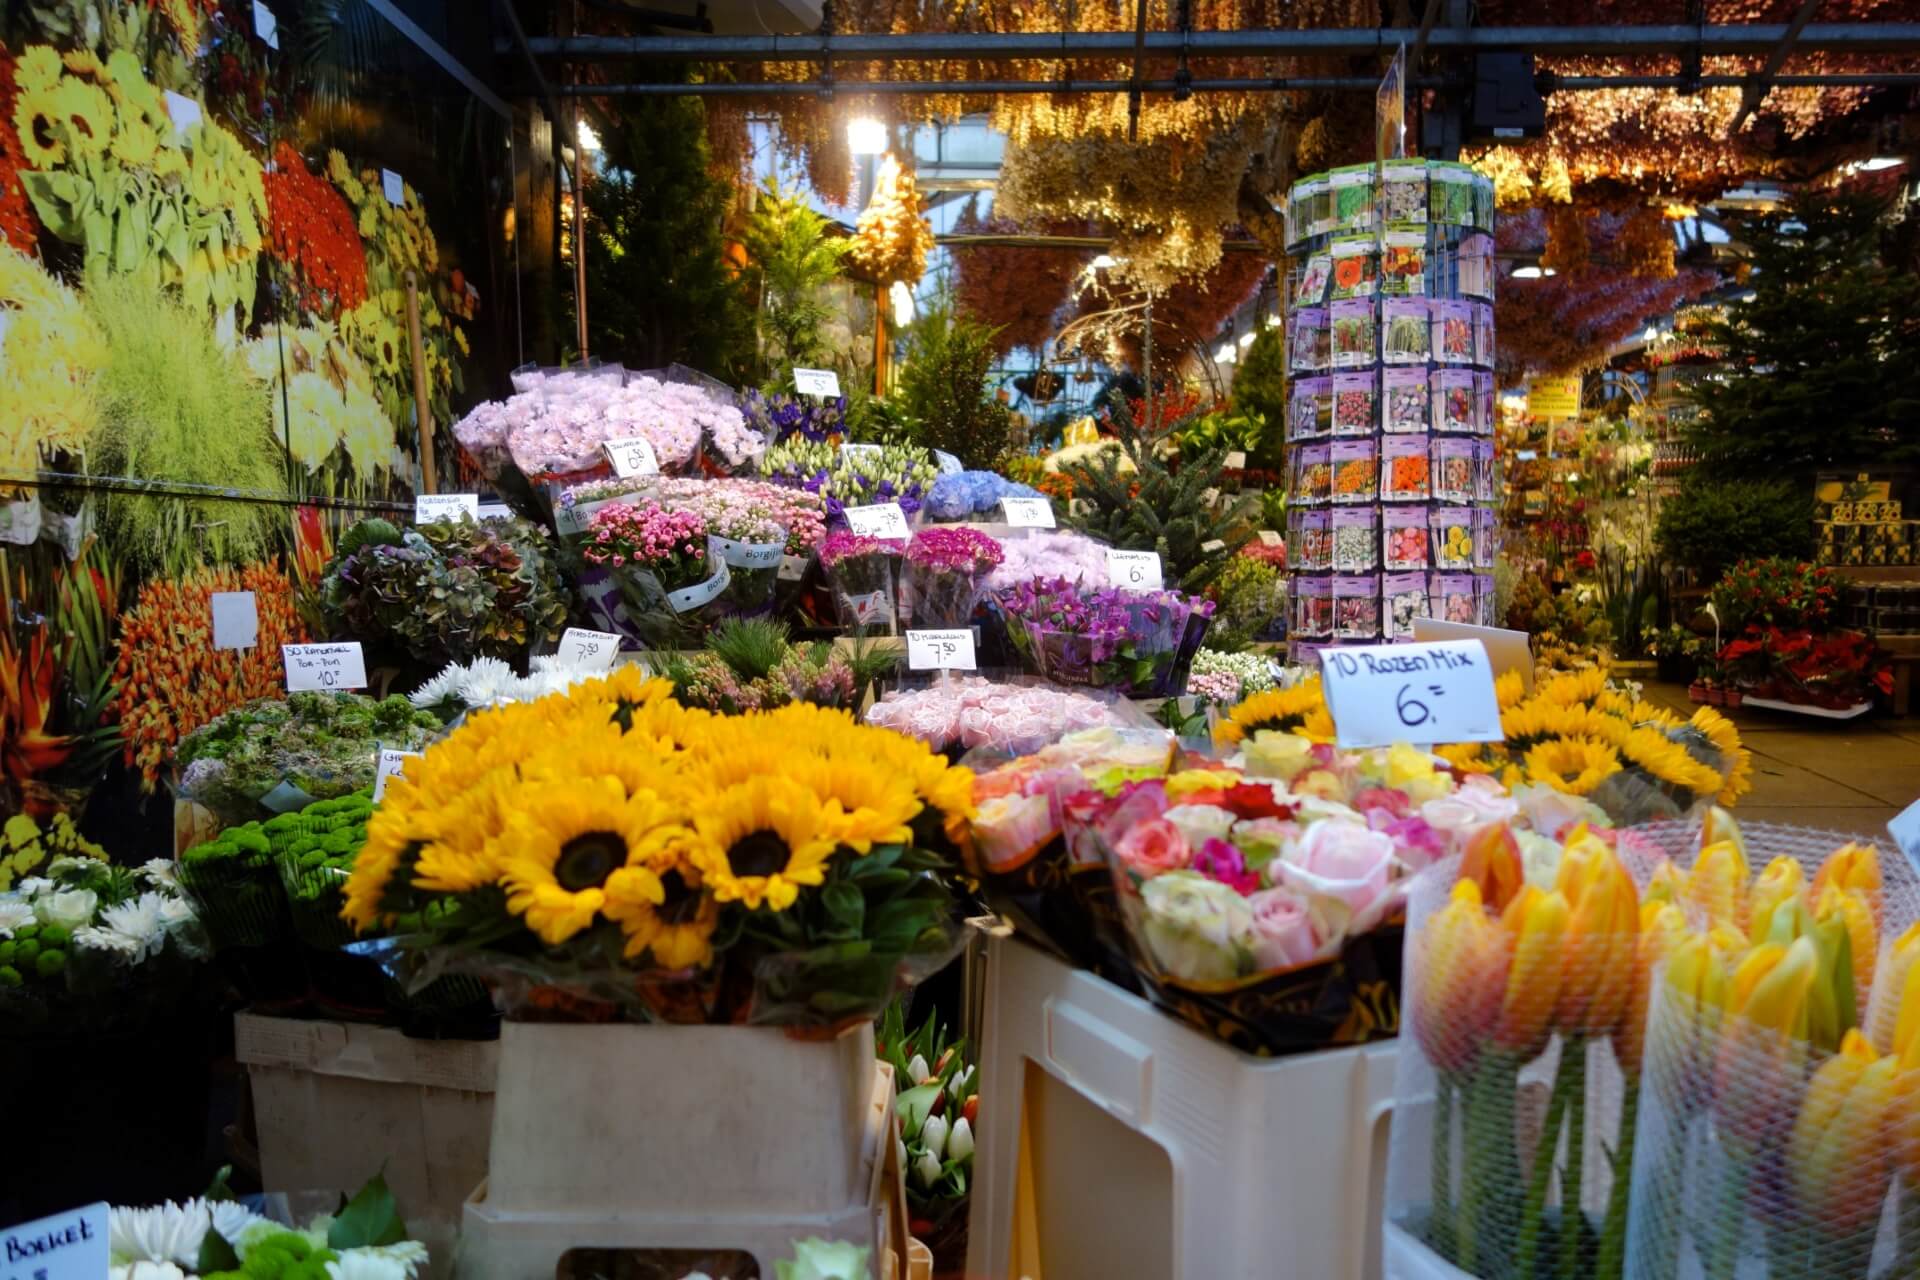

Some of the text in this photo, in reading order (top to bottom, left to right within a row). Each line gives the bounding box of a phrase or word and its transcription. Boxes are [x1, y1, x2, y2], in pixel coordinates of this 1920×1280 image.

[1328, 649, 1475, 678] 10 Rozen Mix
[5, 1215, 95, 1264] Boeket
